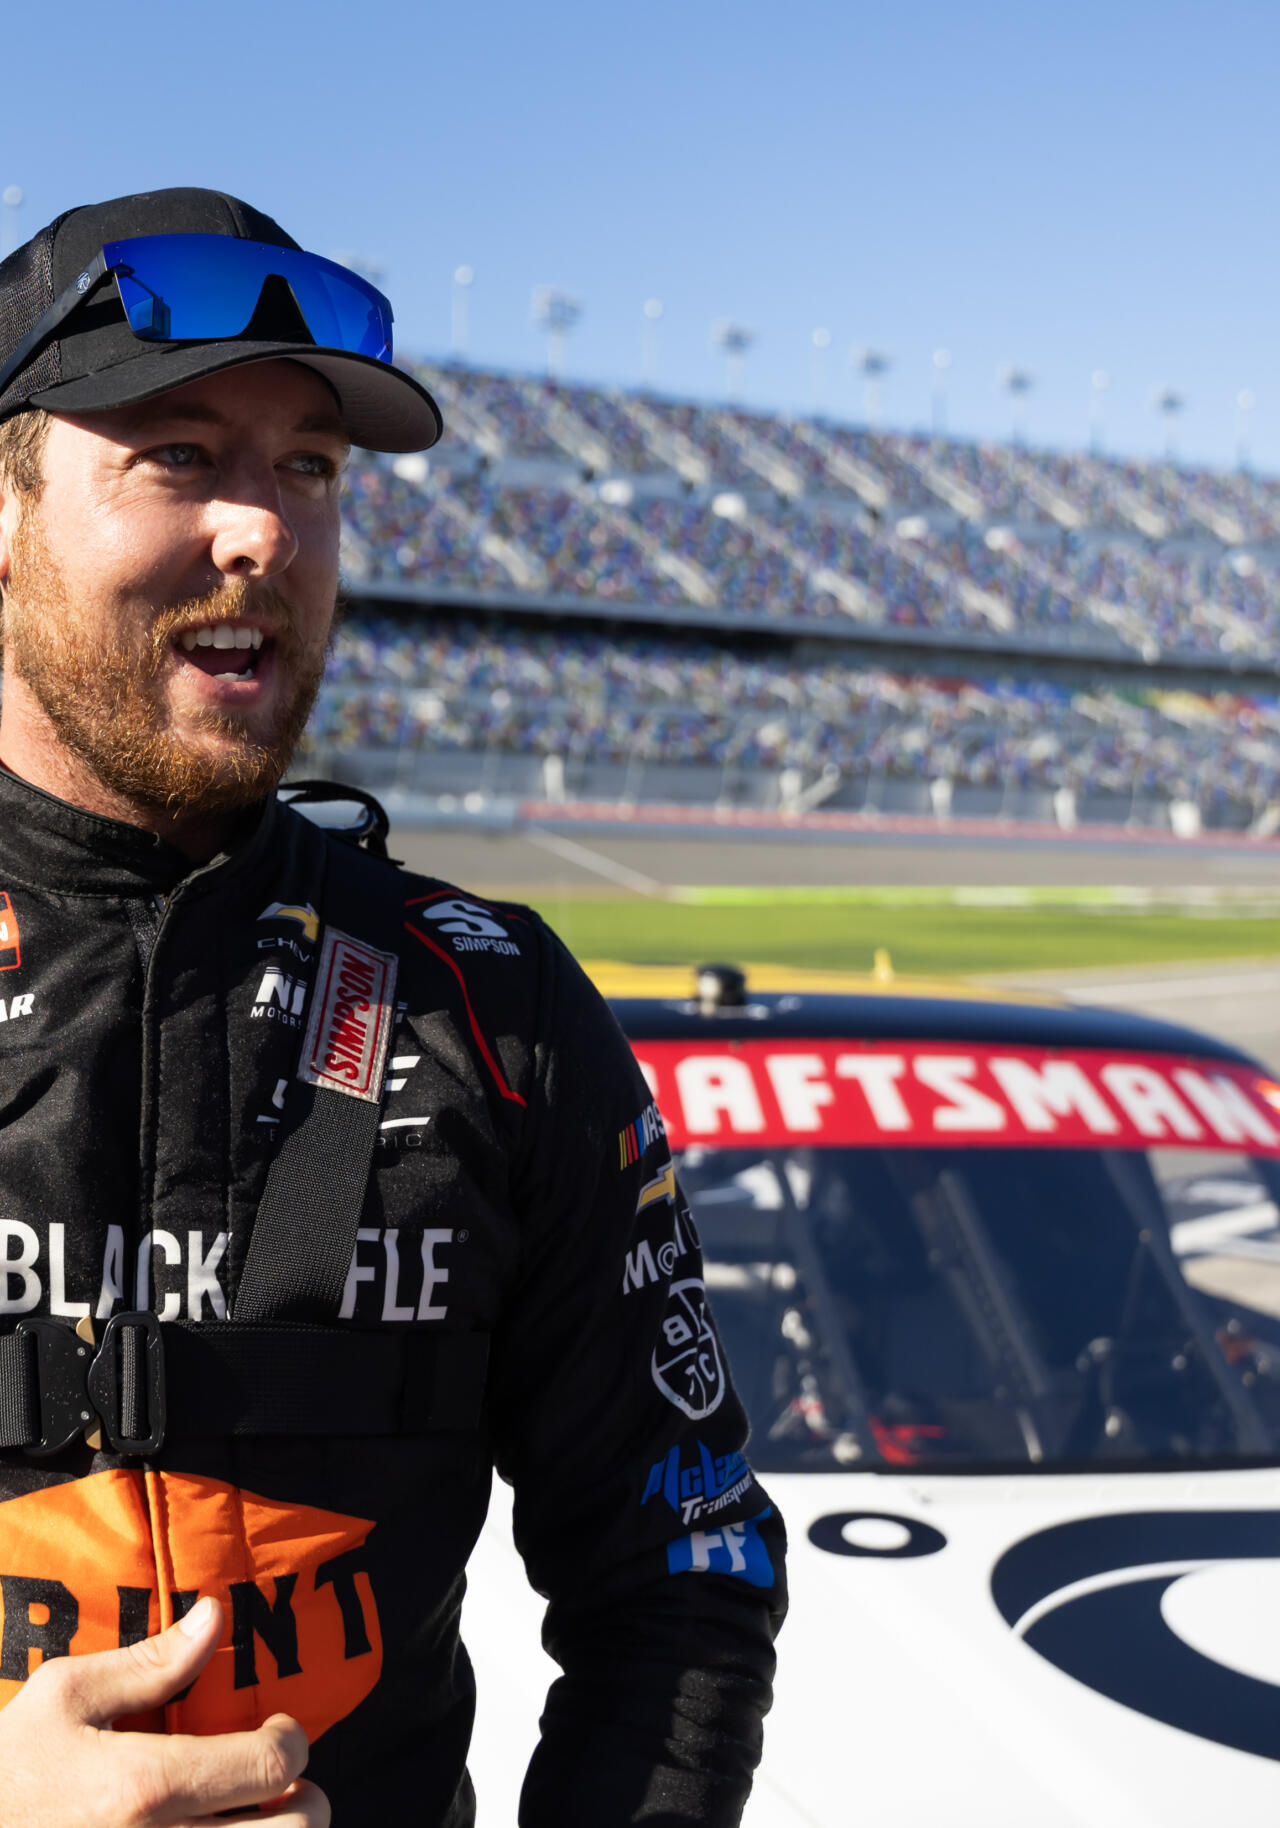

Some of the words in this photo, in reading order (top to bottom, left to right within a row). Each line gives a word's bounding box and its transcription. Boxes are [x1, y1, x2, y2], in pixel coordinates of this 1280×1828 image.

[452, 936, 521, 956] SIMPSON
[324, 951, 376, 1080] SIMPSON
[642, 1104, 666, 1147] NAS
[646, 1053, 1277, 1148] AFTSMAN
[337, 1228, 454, 1322] FLE
